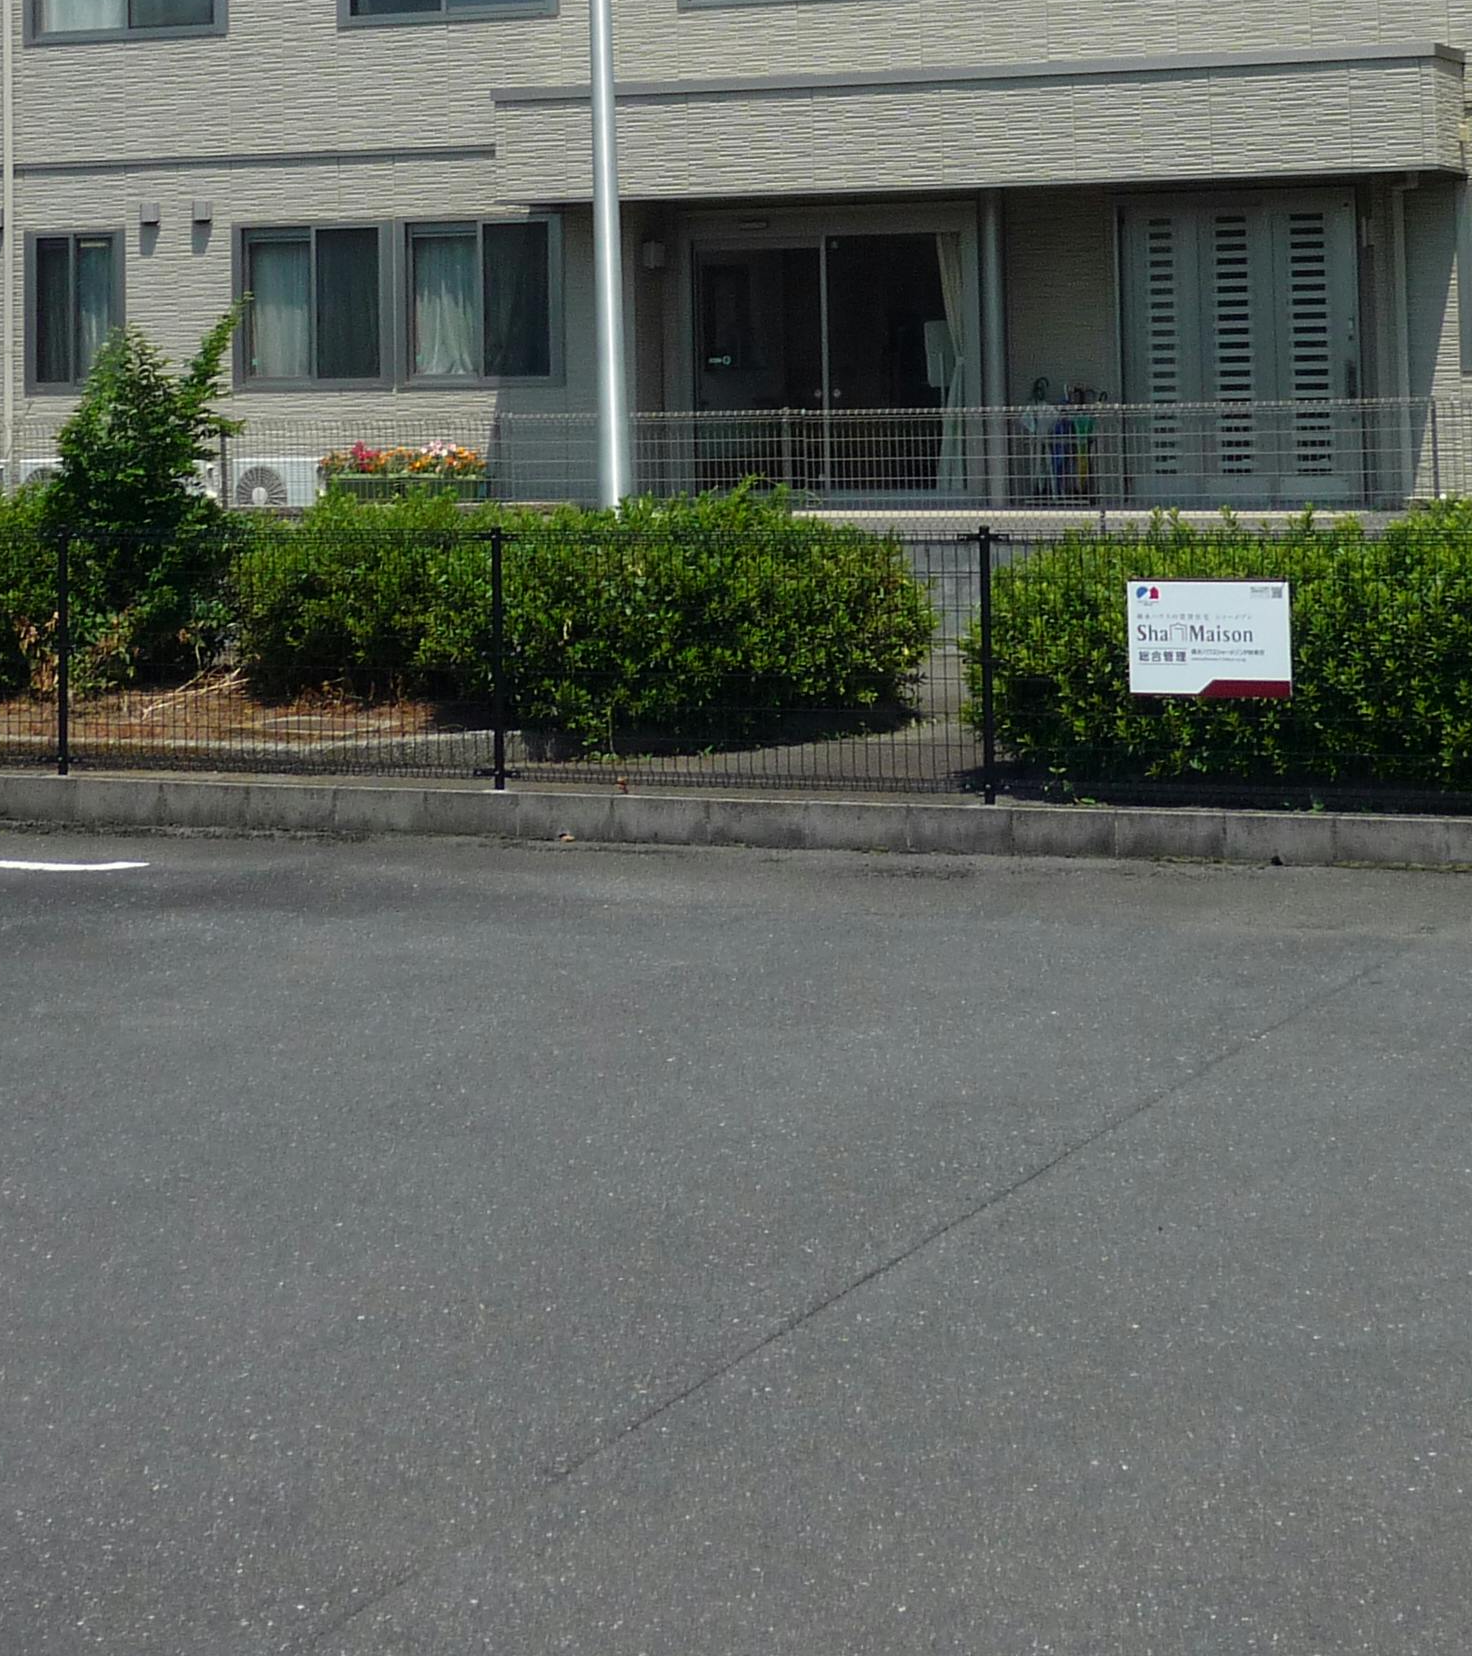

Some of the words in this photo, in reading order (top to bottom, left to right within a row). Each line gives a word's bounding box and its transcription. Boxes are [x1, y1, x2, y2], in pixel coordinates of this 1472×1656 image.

[1136, 624, 1168, 642] Sha
[1189, 625, 1253, 643] Maison
[1138, 650, 1187, 663] 総合管理
